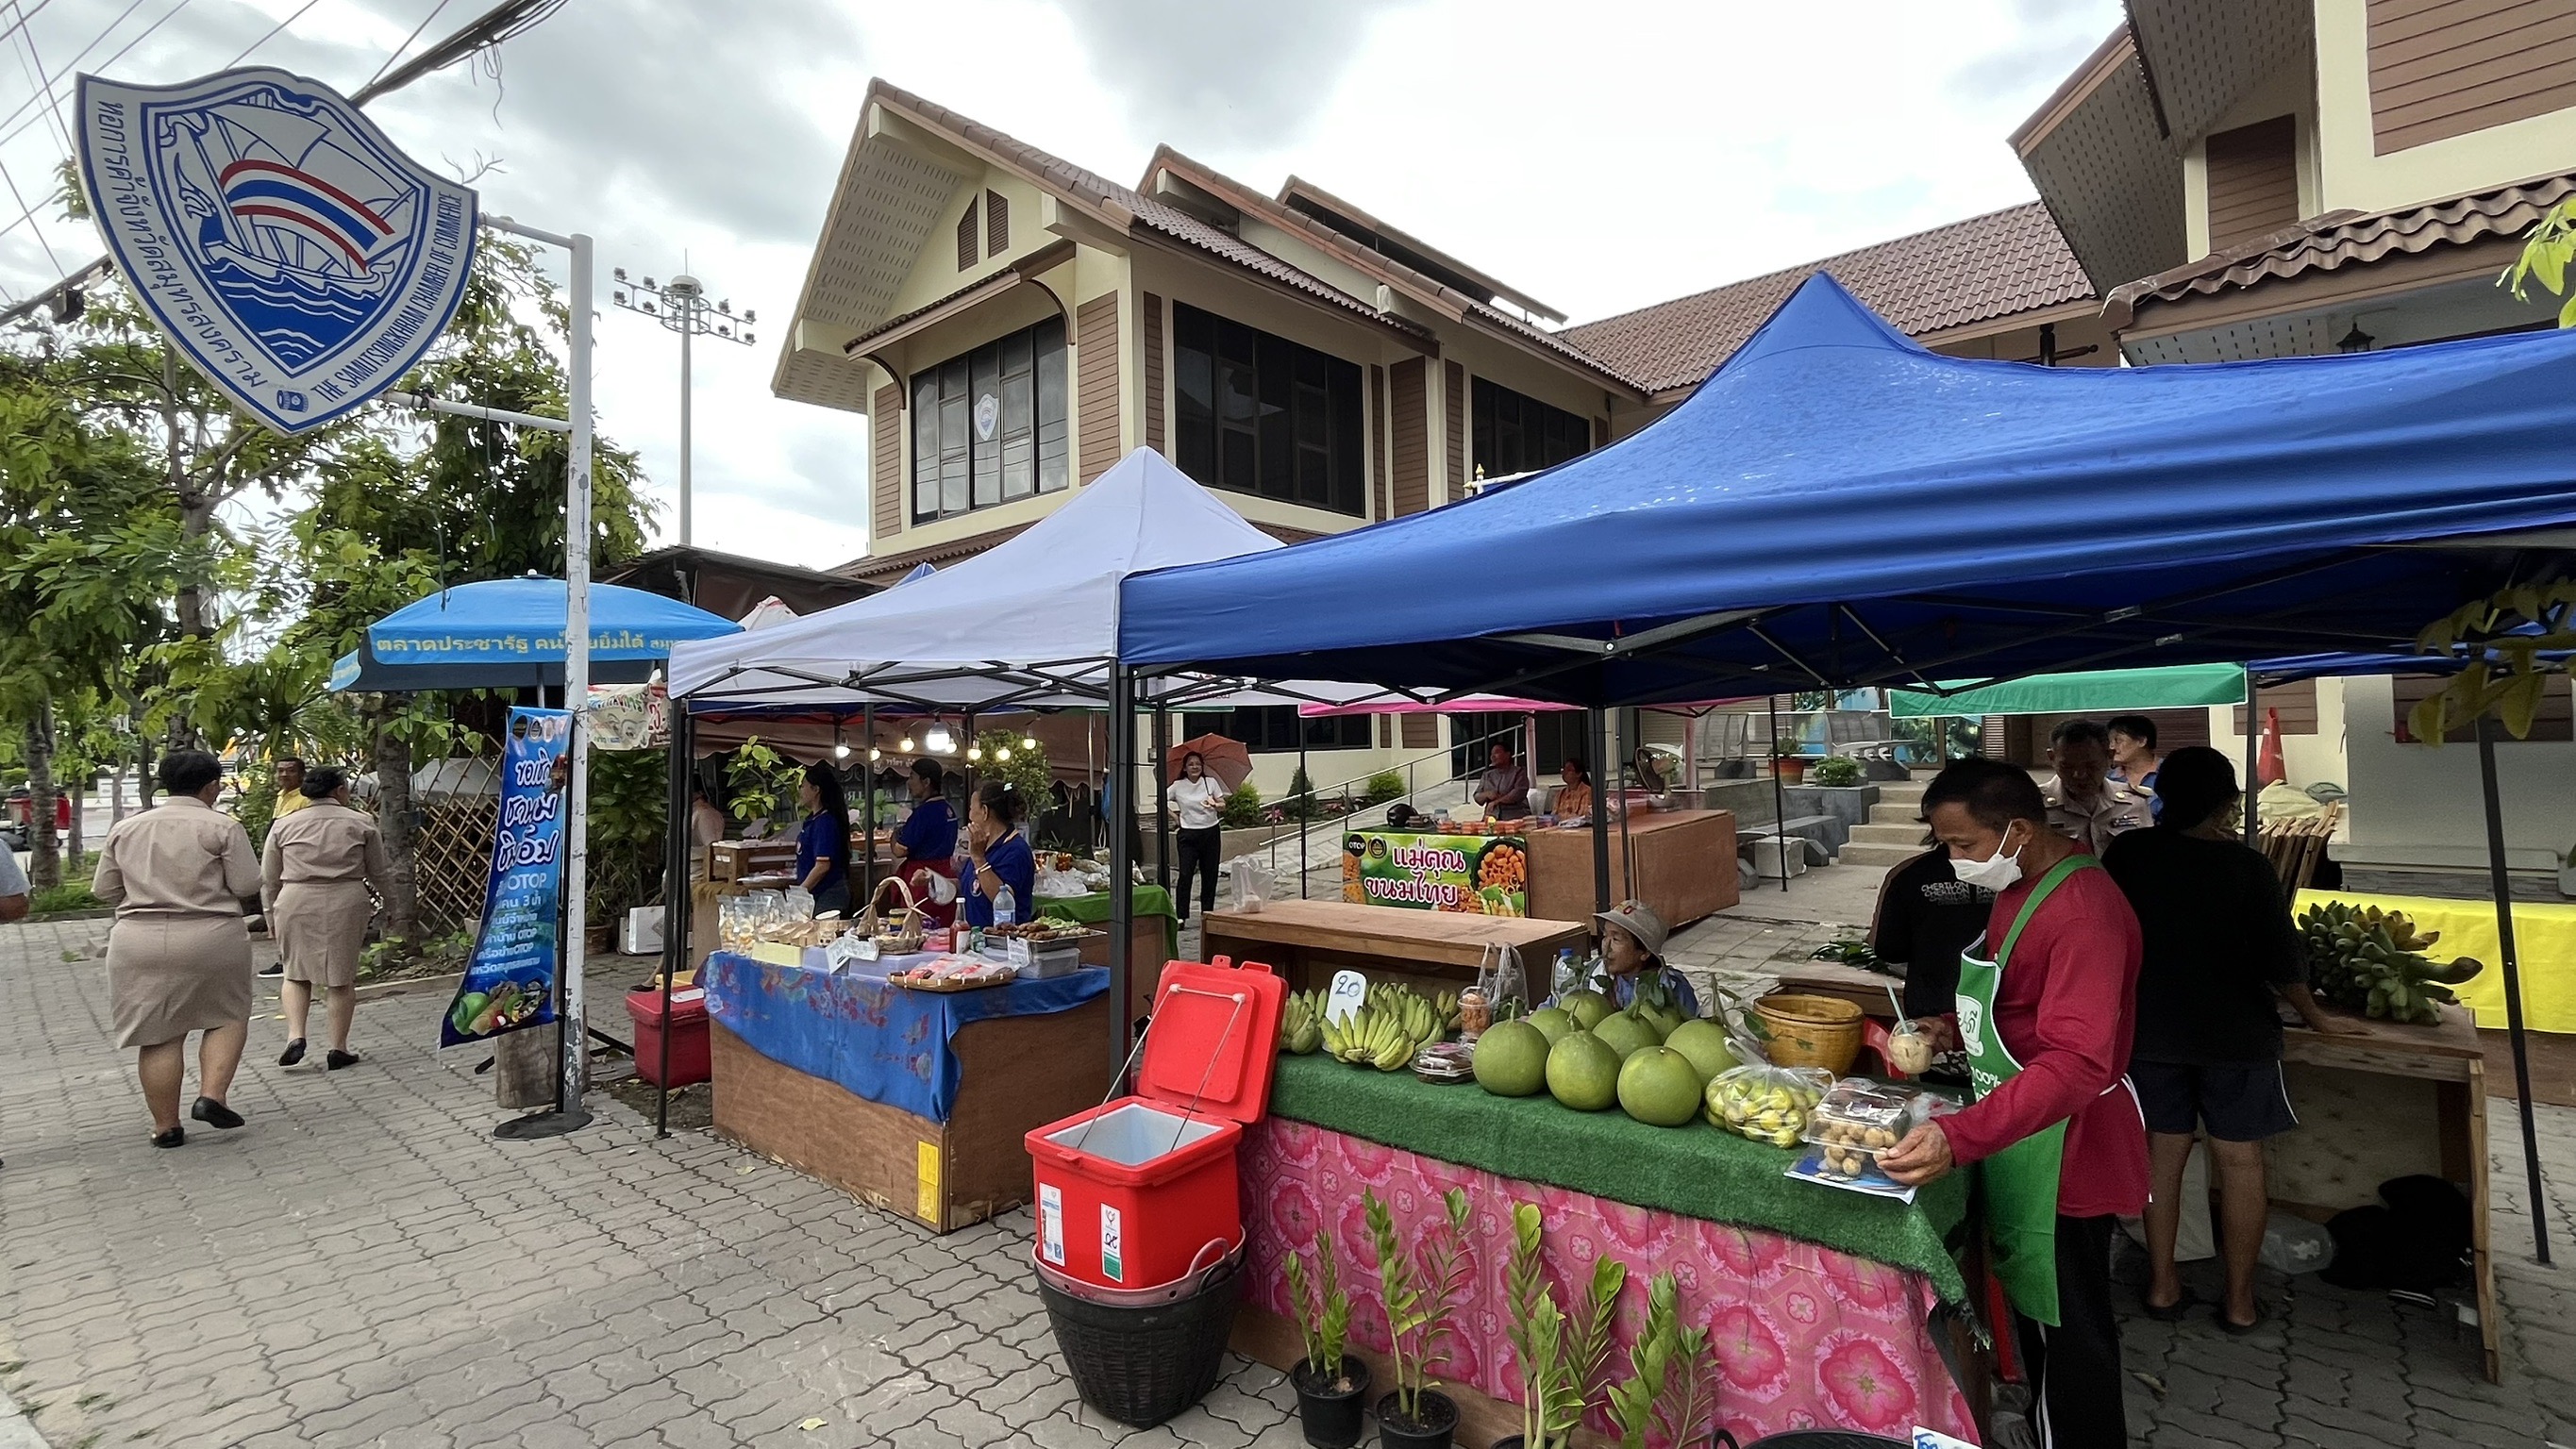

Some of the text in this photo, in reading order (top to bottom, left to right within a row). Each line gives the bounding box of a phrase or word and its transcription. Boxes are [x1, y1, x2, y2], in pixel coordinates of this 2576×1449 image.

[97, 100, 268, 388] หอการค้าจังหวัดสมุทรสงคราม
[309, 191, 462, 403] THE SAMUTSONGKHRAM CHAMBER OF COMMERCE
[377, 635, 528, 653] ตลาดประชารัฐ
[1348, 841, 1365, 850] OTOP
[1394, 839, 1464, 878] แม่คุณ
[508, 873, 547, 890] OTOP
[1365, 871, 1458, 906] ขนมไทย
[523, 894, 529, 907] 3
[1335, 974, 1361, 998] 20
